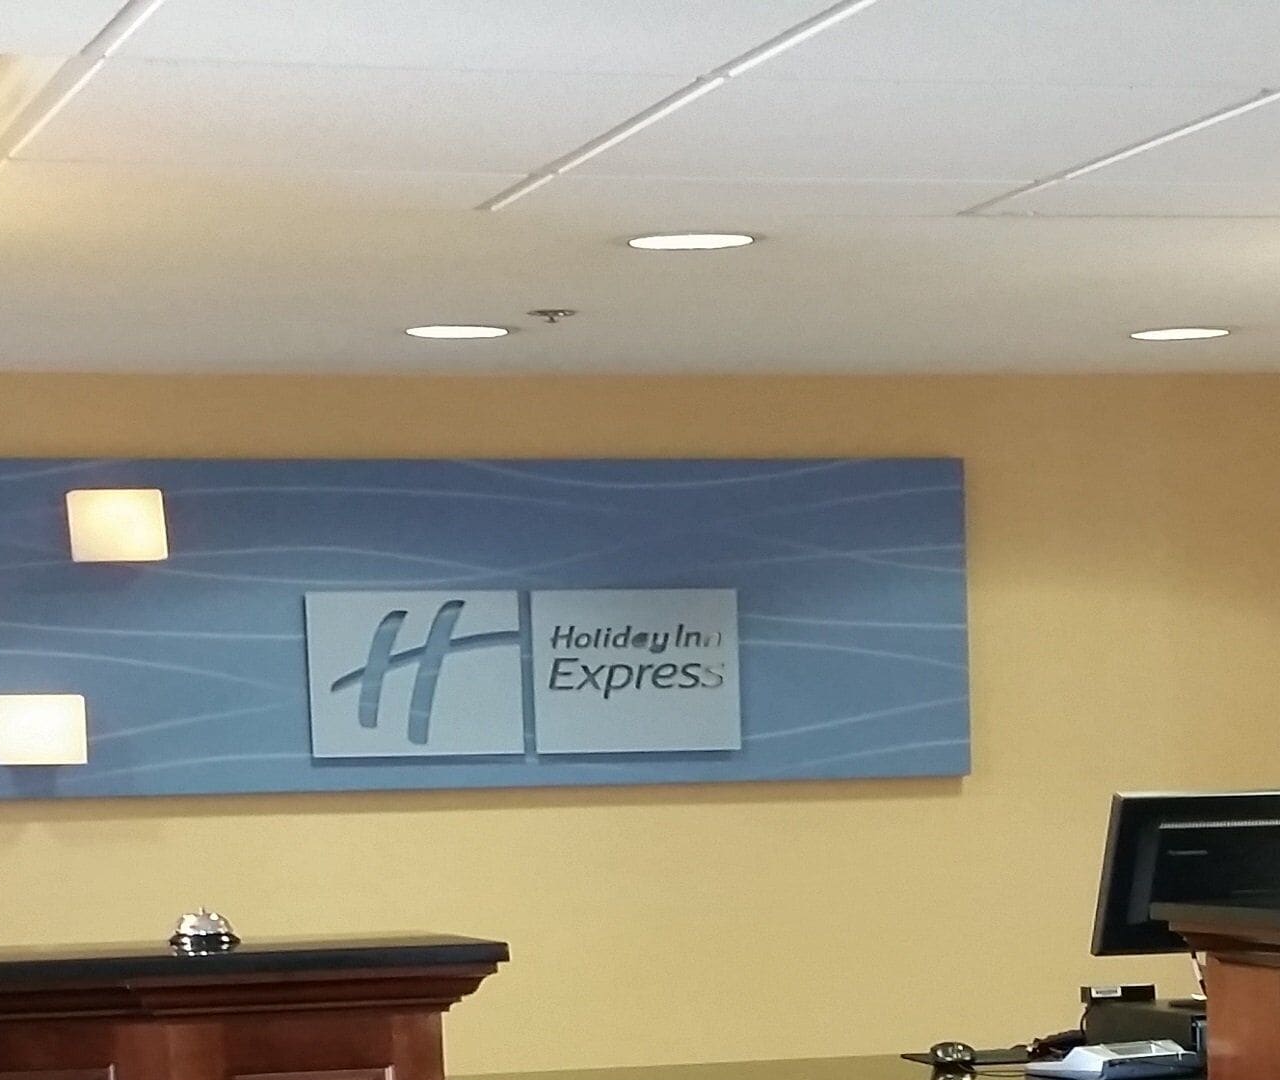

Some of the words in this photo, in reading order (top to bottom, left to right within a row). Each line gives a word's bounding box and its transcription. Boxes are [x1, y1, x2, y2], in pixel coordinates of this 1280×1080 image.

[550, 625, 669, 653] Holiday
[675, 623, 722, 648] Inn
[548, 657, 725, 699] Express
